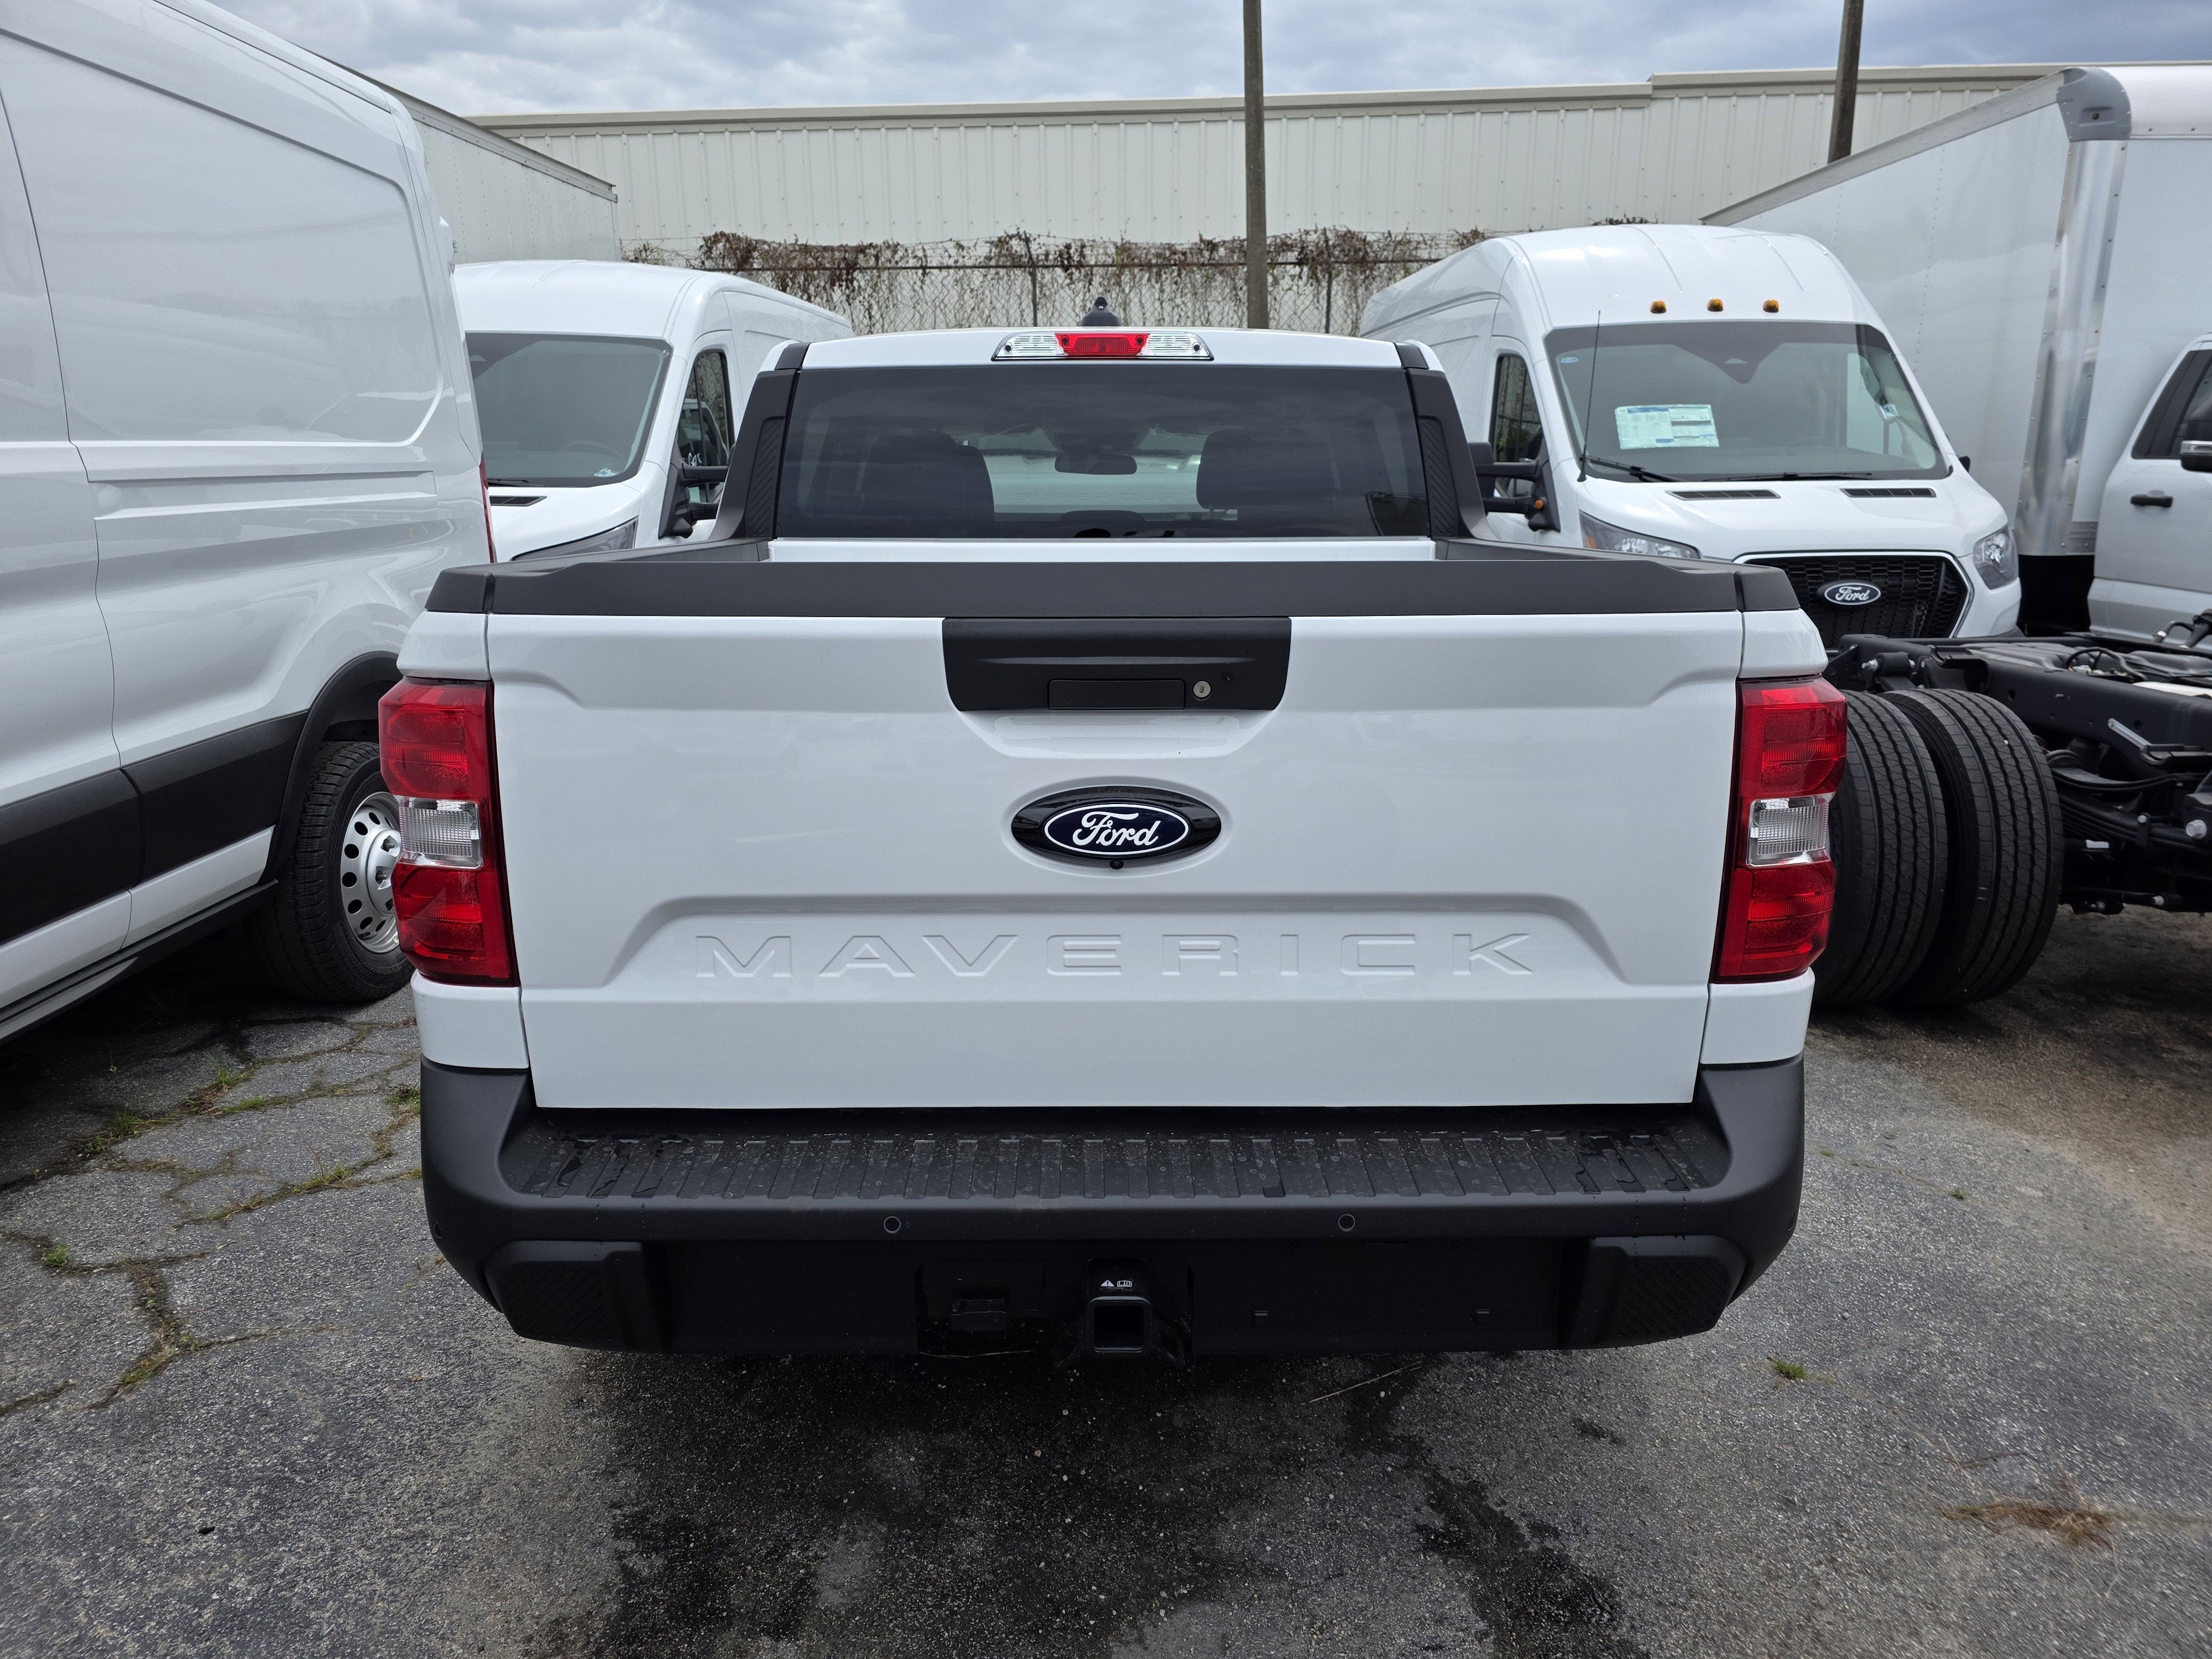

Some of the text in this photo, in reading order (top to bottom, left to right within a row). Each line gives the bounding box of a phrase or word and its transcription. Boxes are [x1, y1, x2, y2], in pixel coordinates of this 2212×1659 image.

[1835, 586, 1870, 601] Ford
[1072, 811, 1161, 846] Ford
[696, 933, 1533, 978] MAVERICK
